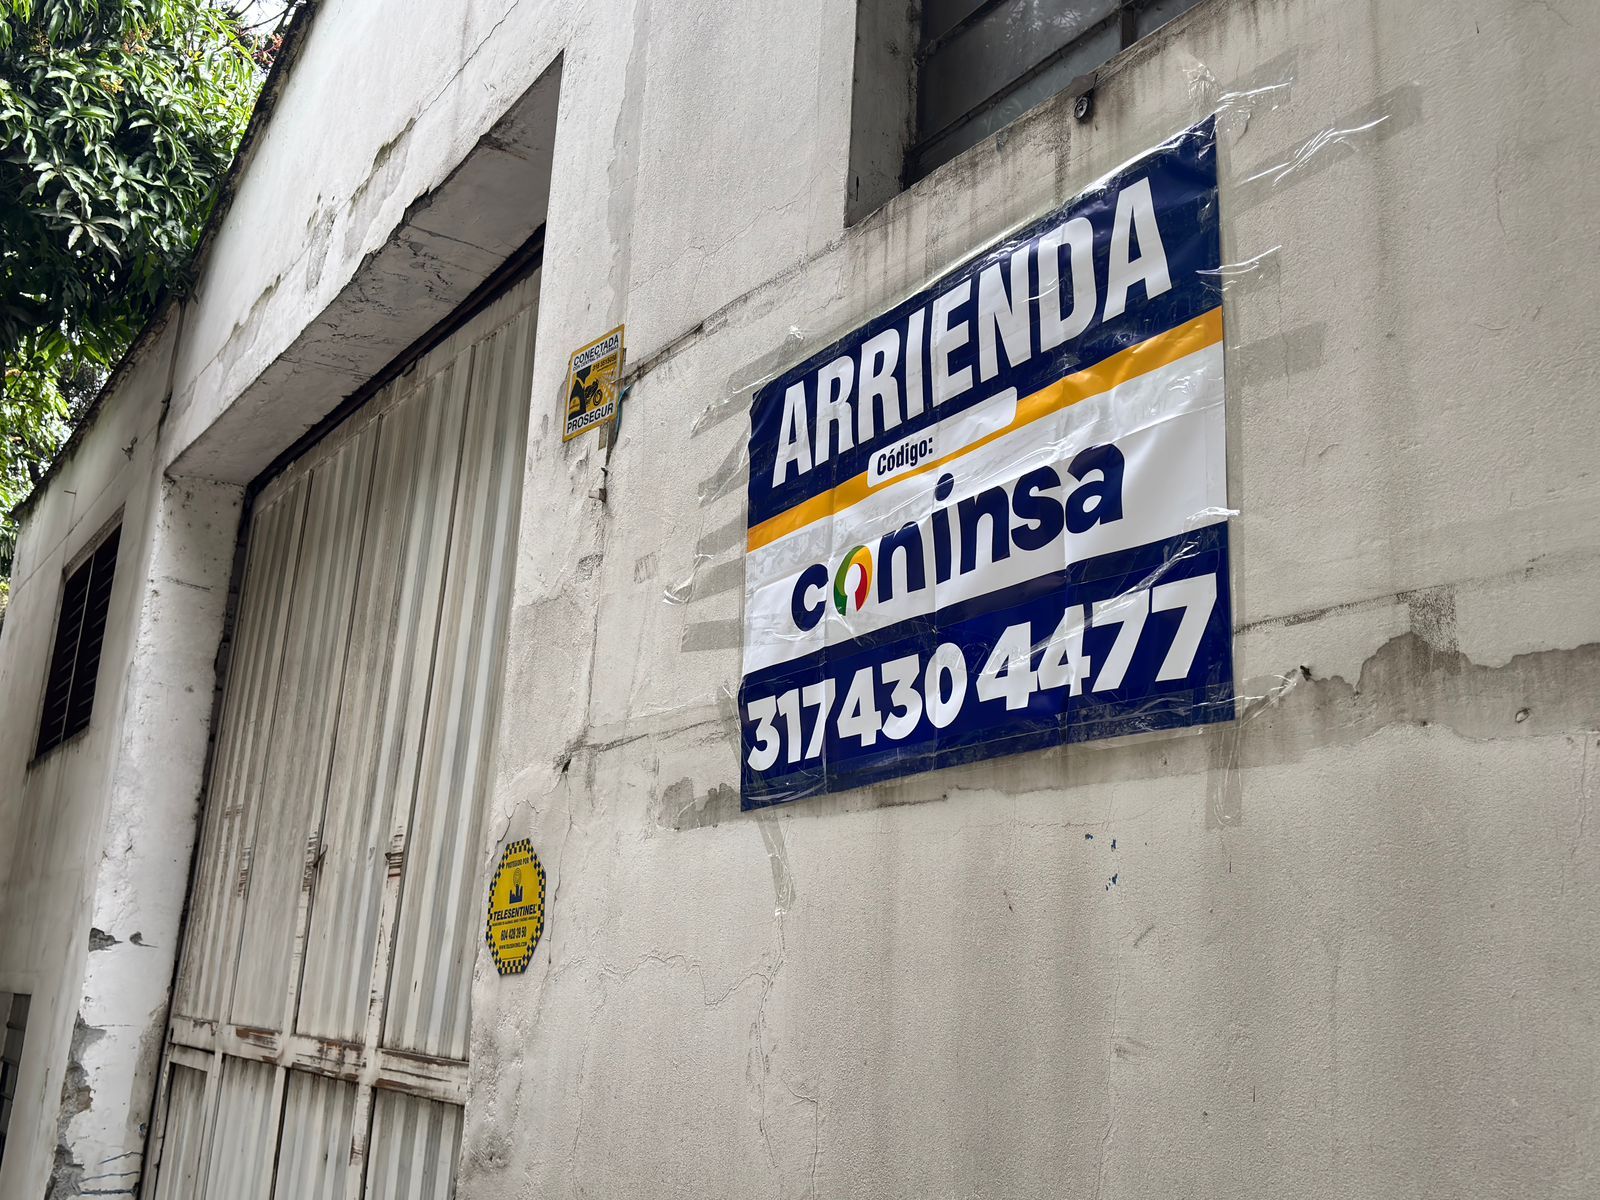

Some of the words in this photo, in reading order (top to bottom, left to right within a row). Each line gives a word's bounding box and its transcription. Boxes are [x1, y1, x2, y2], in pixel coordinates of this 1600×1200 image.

[573, 334, 619, 366] CONECTADA
[773, 177, 1172, 488] ARRIENDA
[567, 402, 614, 433] PROSEGUR
[877, 437, 933, 476] Código:
[791, 443, 1125, 632] coninsa
[976, 572, 1218, 711] 4477
[493, 904, 537, 921] TELESENTINEL
